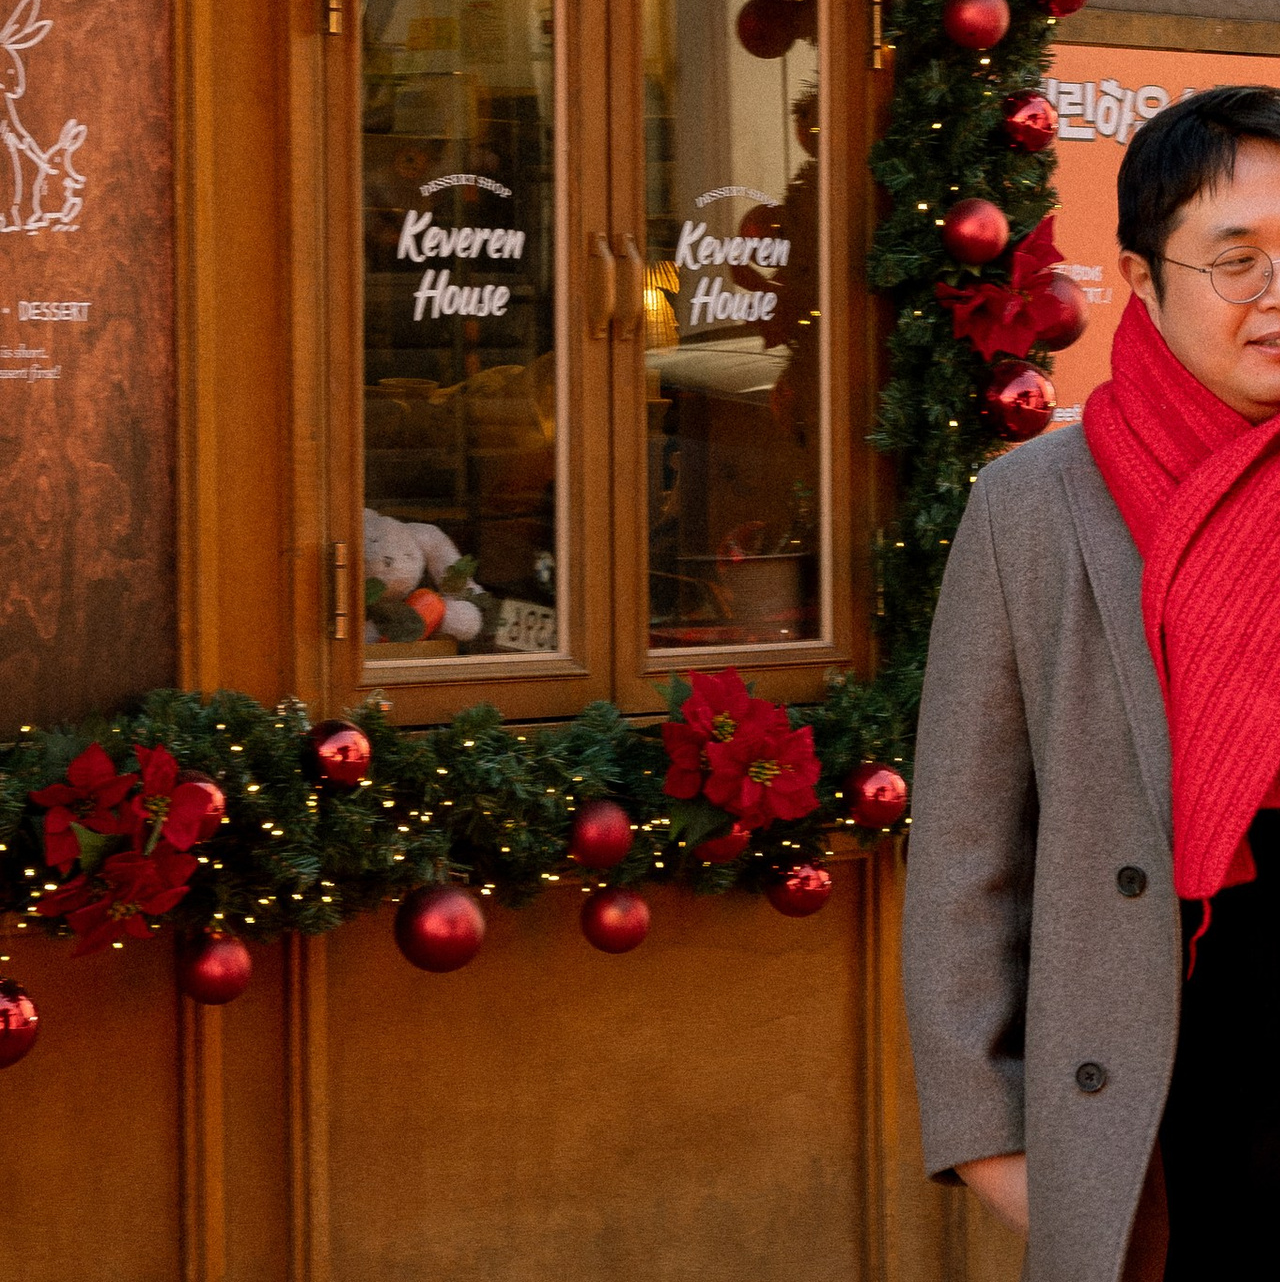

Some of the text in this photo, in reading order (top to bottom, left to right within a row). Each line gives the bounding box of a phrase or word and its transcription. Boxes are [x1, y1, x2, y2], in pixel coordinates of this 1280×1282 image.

[396, 209, 526, 263] Keveren
[674, 220, 791, 271] Keveren
[18, 301, 92, 321] DESSERT
[413, 268, 511, 322] House
[689, 276, 778, 326] House
